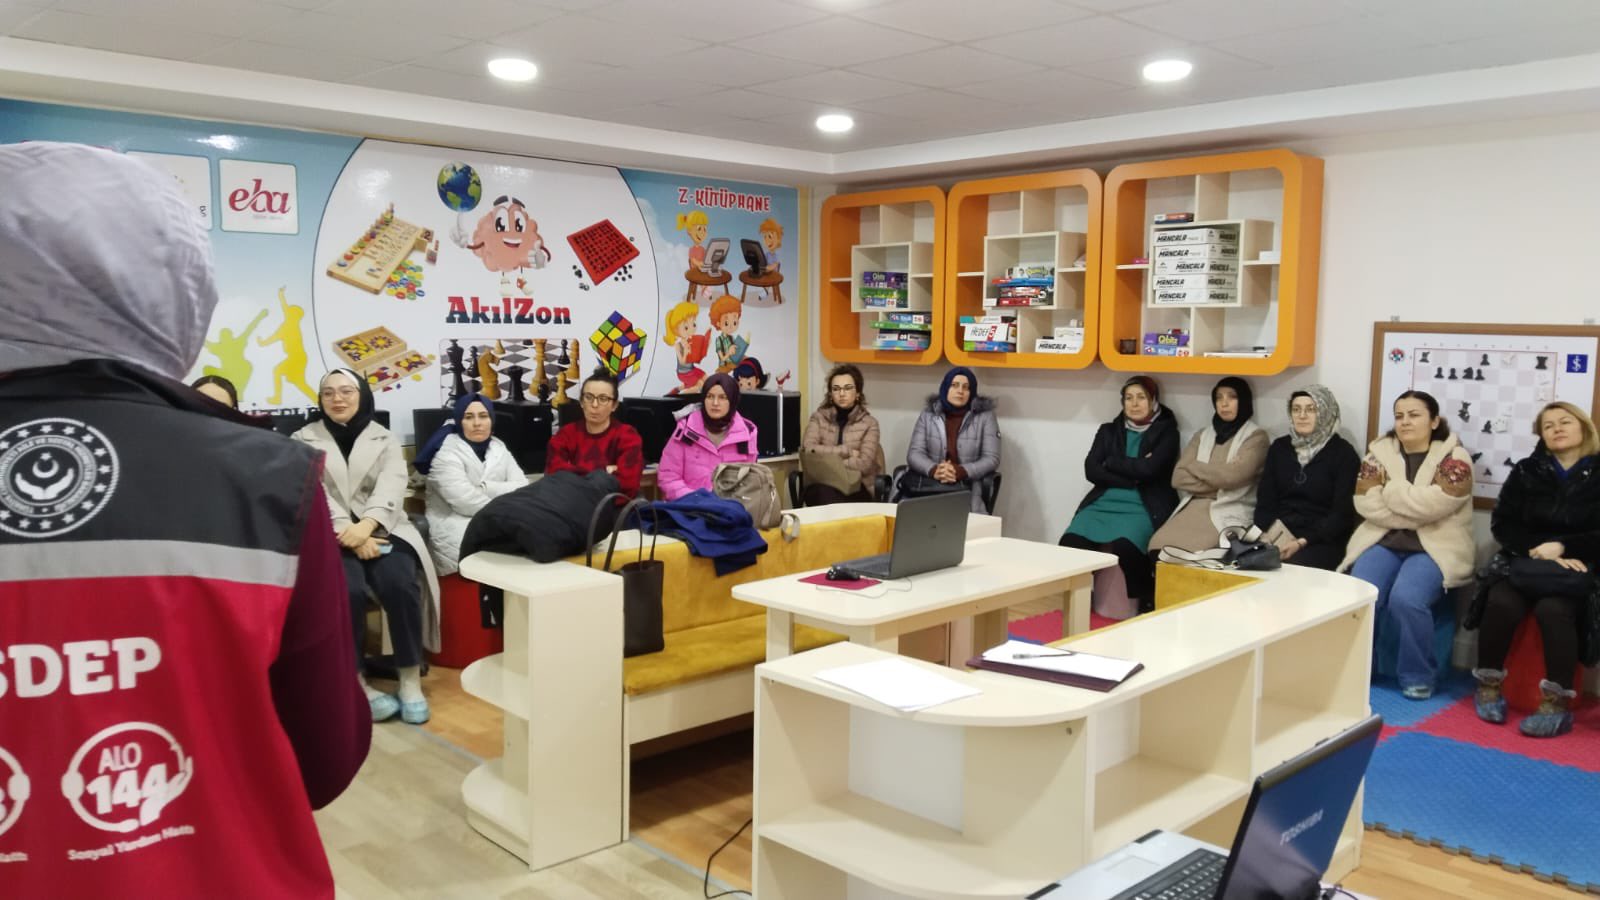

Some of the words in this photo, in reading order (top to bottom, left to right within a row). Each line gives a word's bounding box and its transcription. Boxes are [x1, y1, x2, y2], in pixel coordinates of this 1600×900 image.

[229, 178, 291, 214] eba
[446, 296, 571, 324] AkılZon
[0, 637, 161, 698] DEP
[98, 742, 142, 774] ALO
[86, 763, 168, 815] 144
